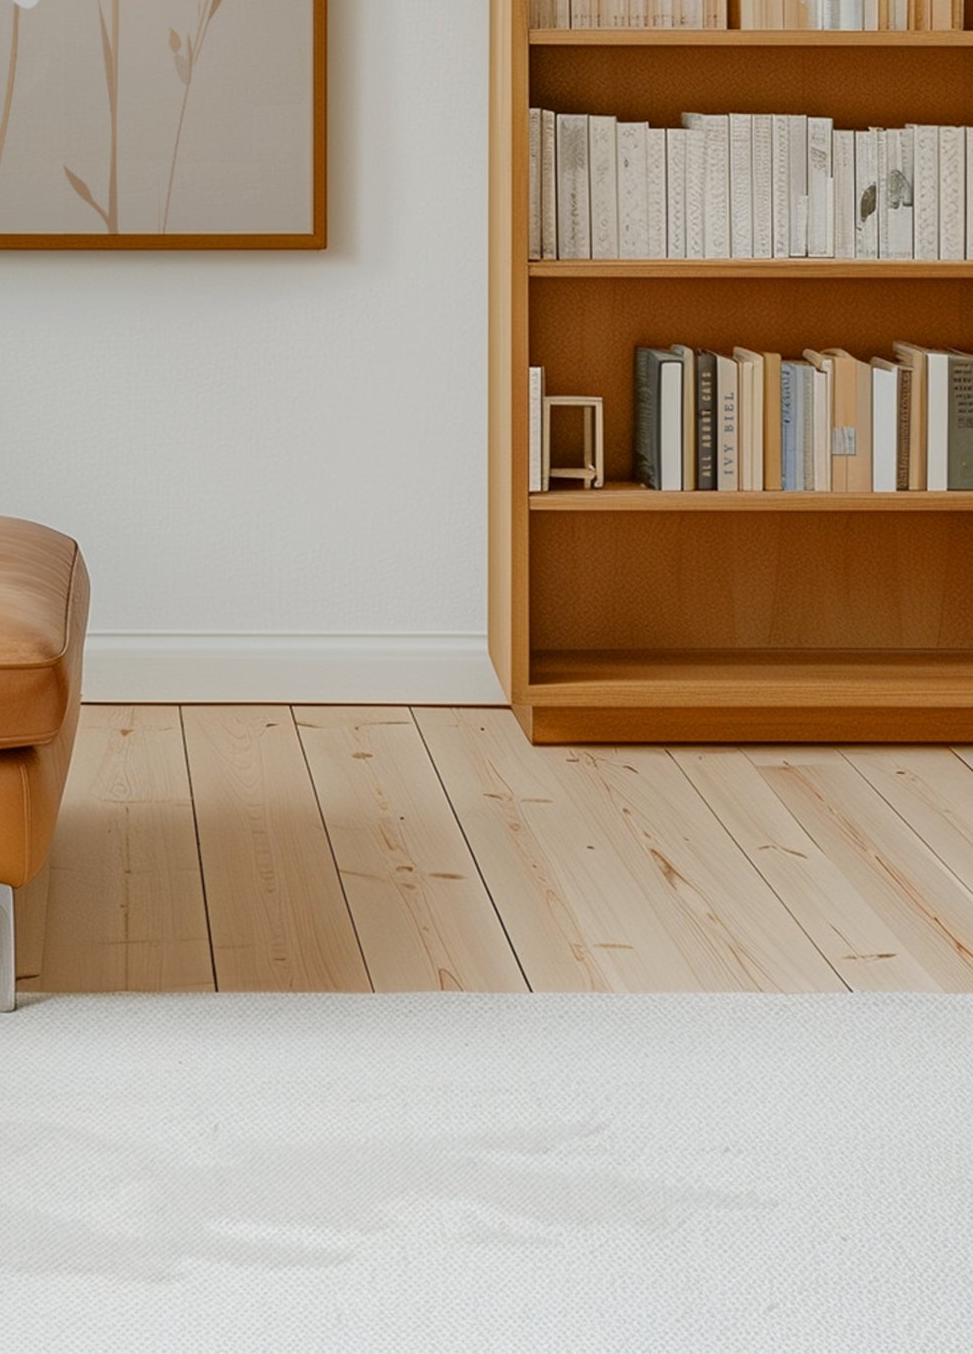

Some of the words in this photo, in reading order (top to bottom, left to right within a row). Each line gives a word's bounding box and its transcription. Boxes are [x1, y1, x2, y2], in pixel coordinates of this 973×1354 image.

[701, 371, 712, 401] CATS
[723, 392, 734, 433] BIEL
[701, 409, 712, 448] ABOUT
[701, 455, 712, 478] ALL
[724, 444, 734, 475] IVY
